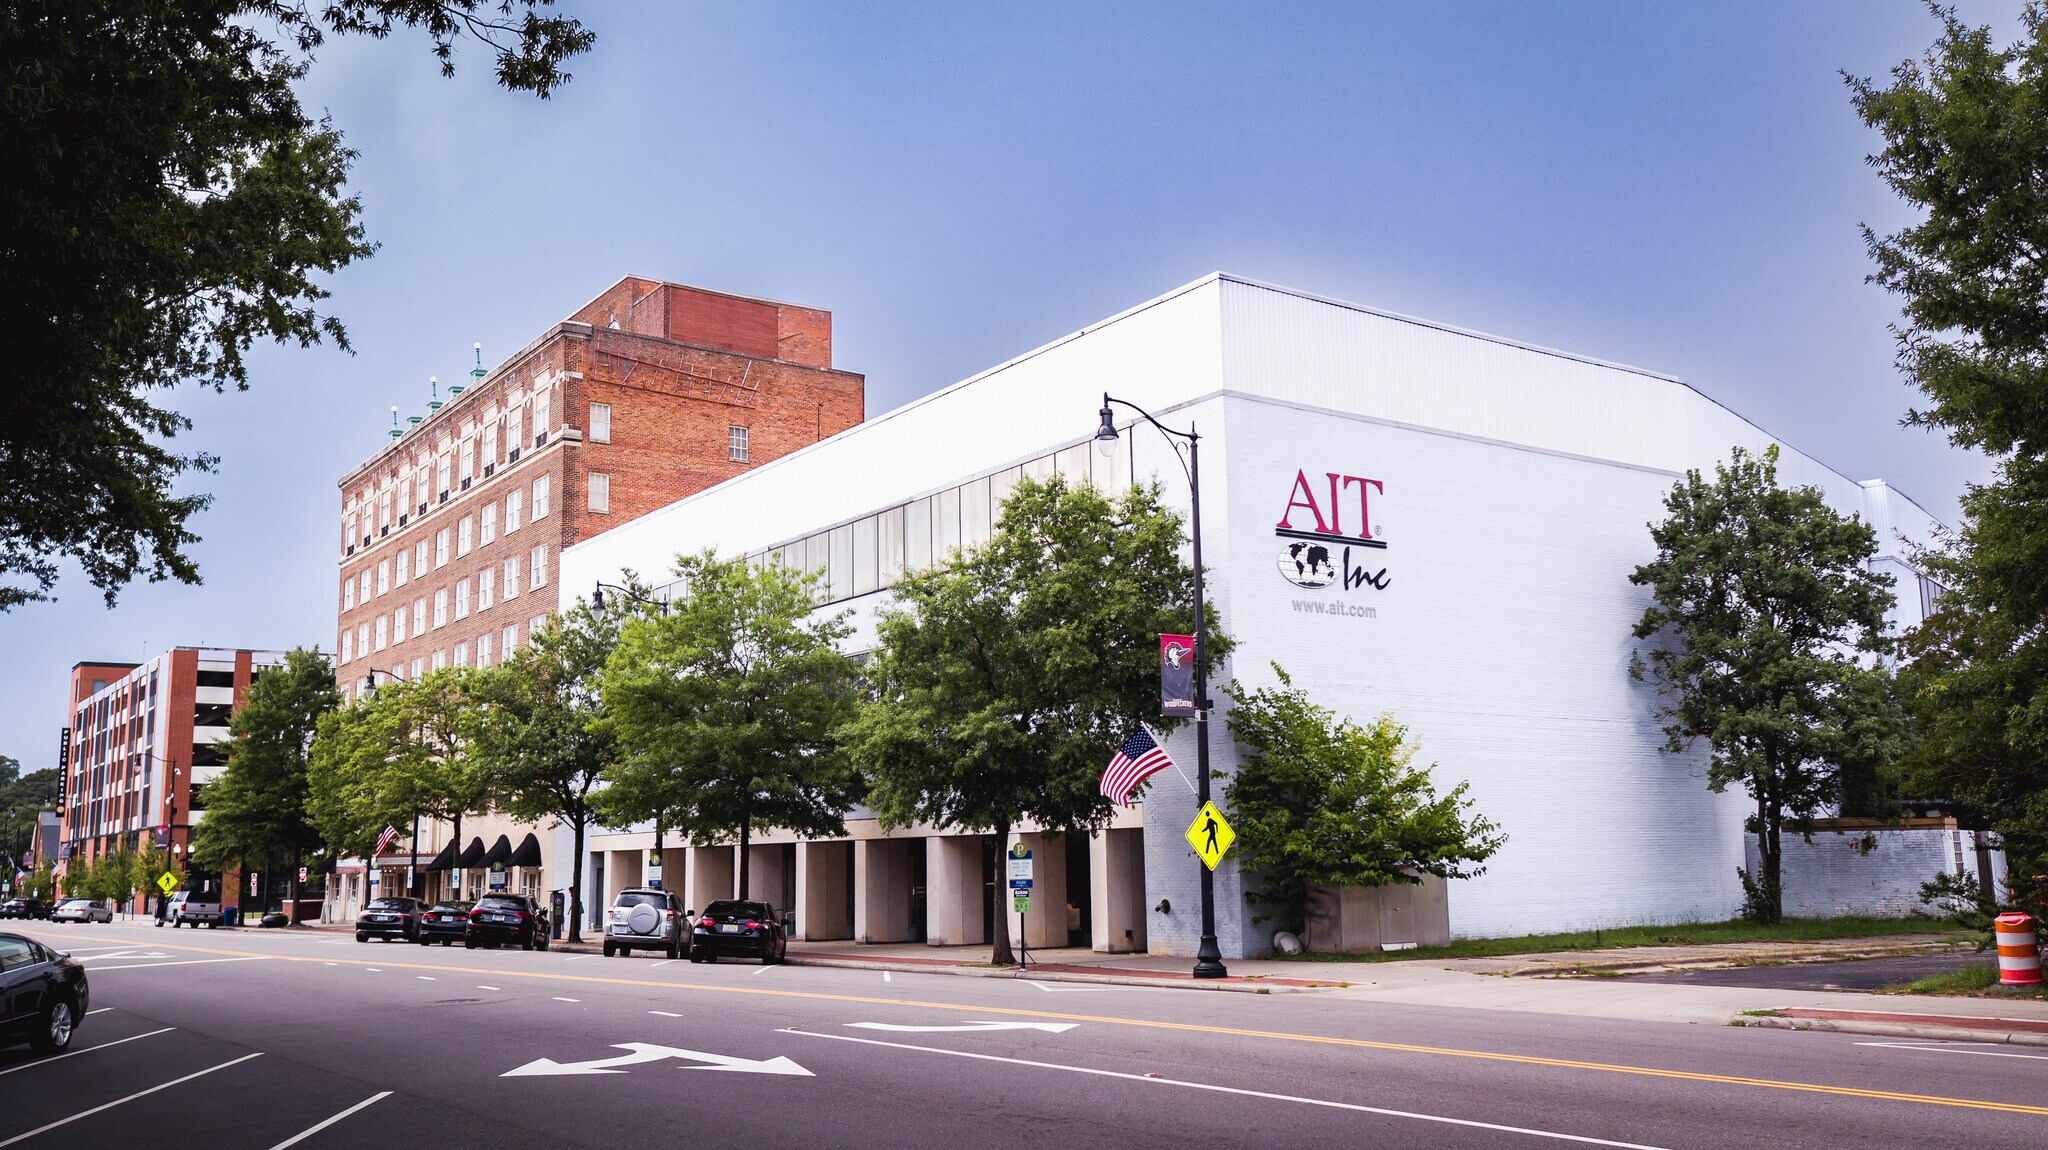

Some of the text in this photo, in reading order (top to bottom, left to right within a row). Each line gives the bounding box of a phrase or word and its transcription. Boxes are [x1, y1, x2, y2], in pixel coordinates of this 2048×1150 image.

[1276, 468, 1384, 539] AIT
[1343, 546, 1391, 591] Inc
[1292, 600, 1377, 618] www.ait.com
[1017, 844, 1023, 855] P
